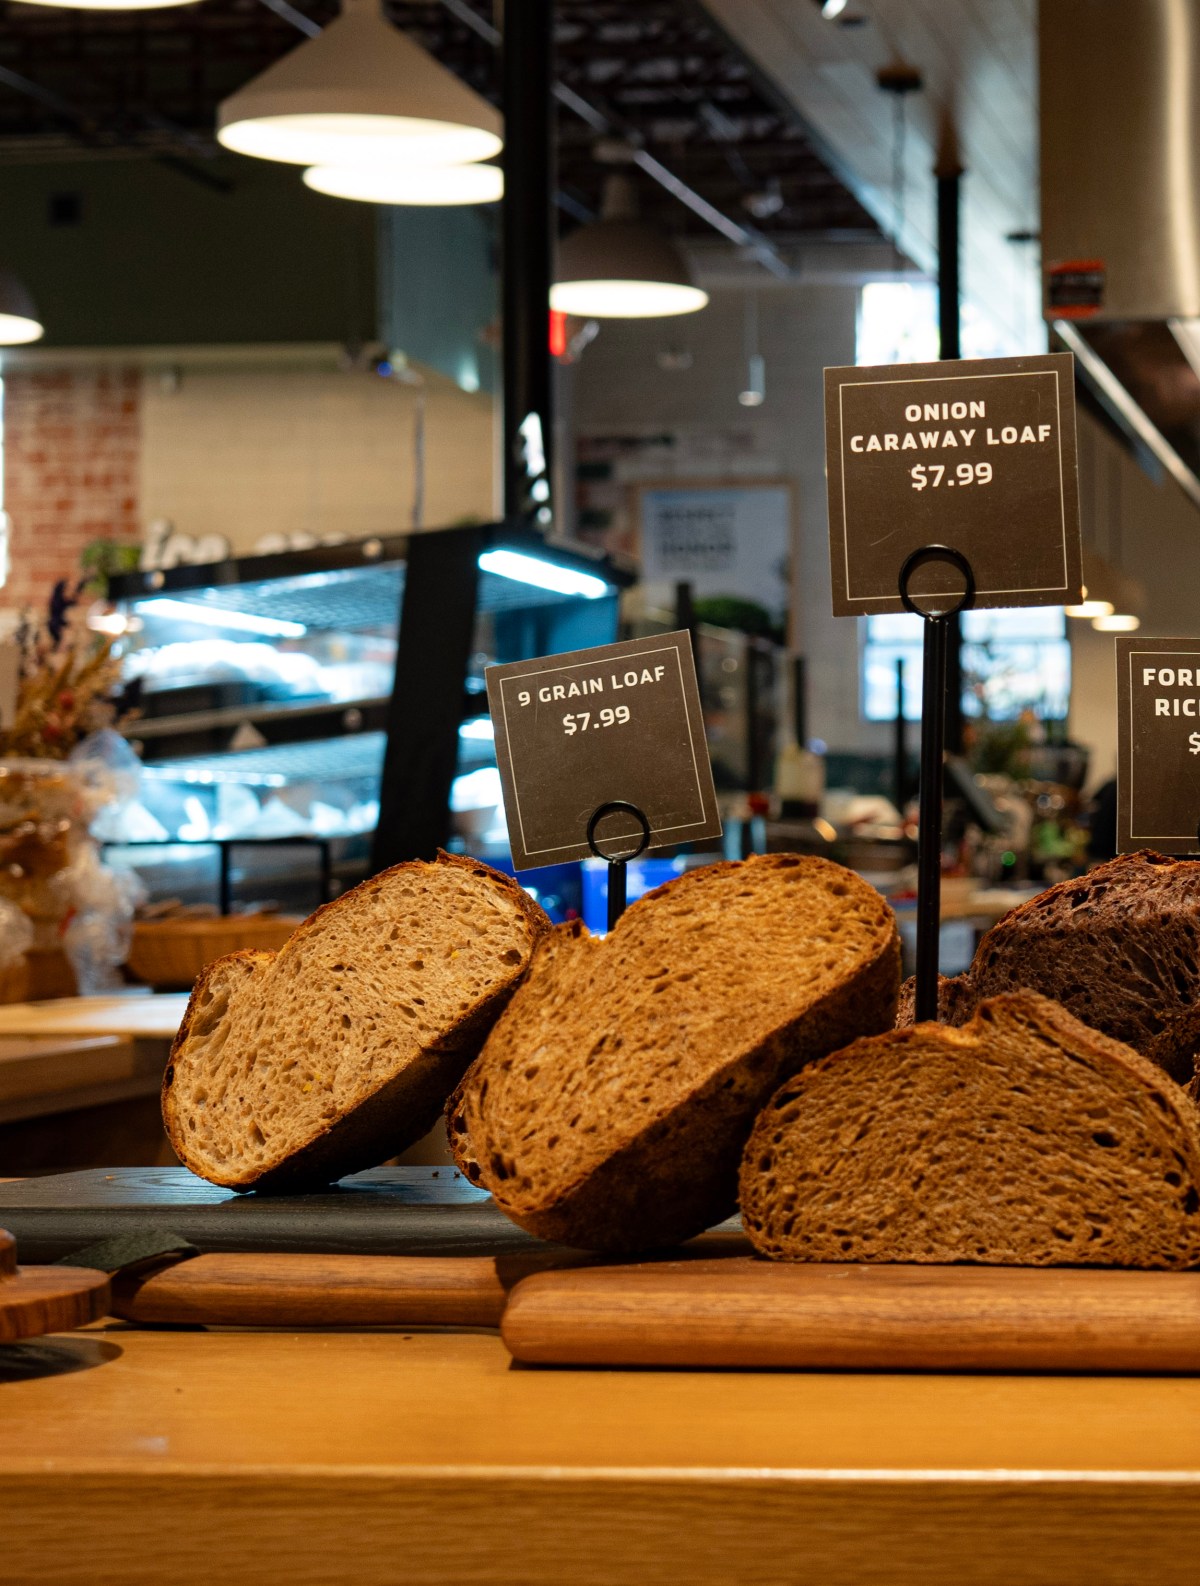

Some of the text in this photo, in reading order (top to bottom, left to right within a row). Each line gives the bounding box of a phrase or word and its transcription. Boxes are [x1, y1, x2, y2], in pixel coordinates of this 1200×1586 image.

[904, 400, 988, 423] ONION
[849, 424, 1052, 453] CARAWAY LOAF
[910, 461, 993, 492] $7.99
[517, 665, 666, 708] 9 GRAIN LOAF
[562, 705, 631, 736] $7.99
